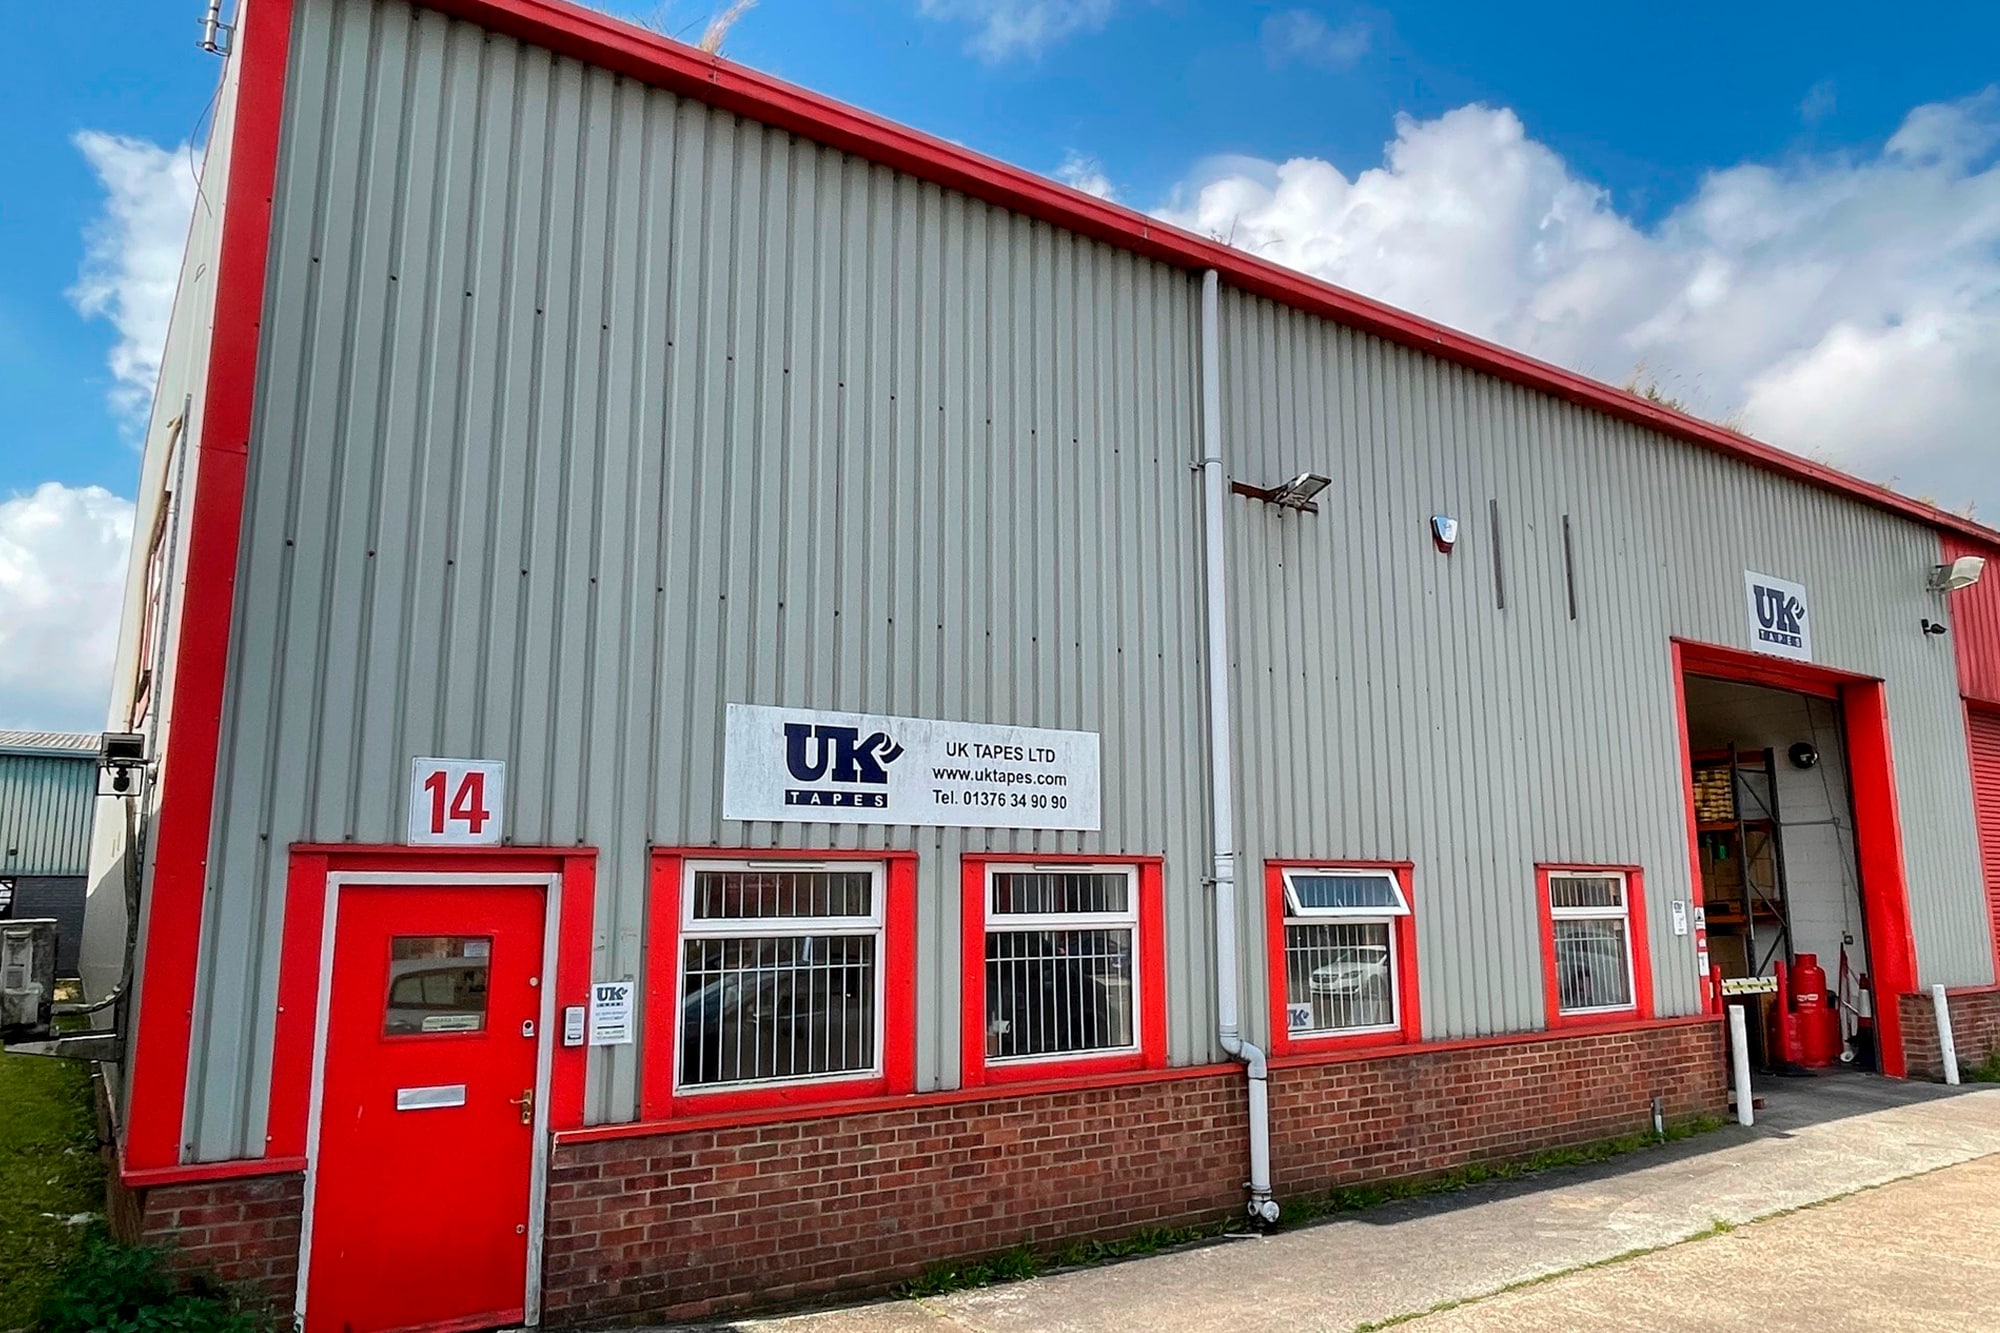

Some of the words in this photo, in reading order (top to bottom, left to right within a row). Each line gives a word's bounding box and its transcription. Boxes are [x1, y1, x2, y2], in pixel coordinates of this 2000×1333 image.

[1753, 584, 1805, 635] UK
[1760, 630, 1801, 648] TAPES
[784, 723, 904, 784] UK
[946, 742, 969, 757] UK
[973, 743, 1024, 761] TAPES
[1028, 748, 1056, 763] LTD
[932, 767, 1067, 786] www.uktapes.com
[424, 770, 490, 834] 14
[790, 791, 884, 807] TAPES
[932, 789, 958, 805] Tel.
[963, 791, 1006, 807] 01376
[1010, 793, 1027, 808] 34
[1031, 794, 1047, 809] 90
[1051, 795, 1067, 809] 90
[597, 987, 628, 1001] UK
